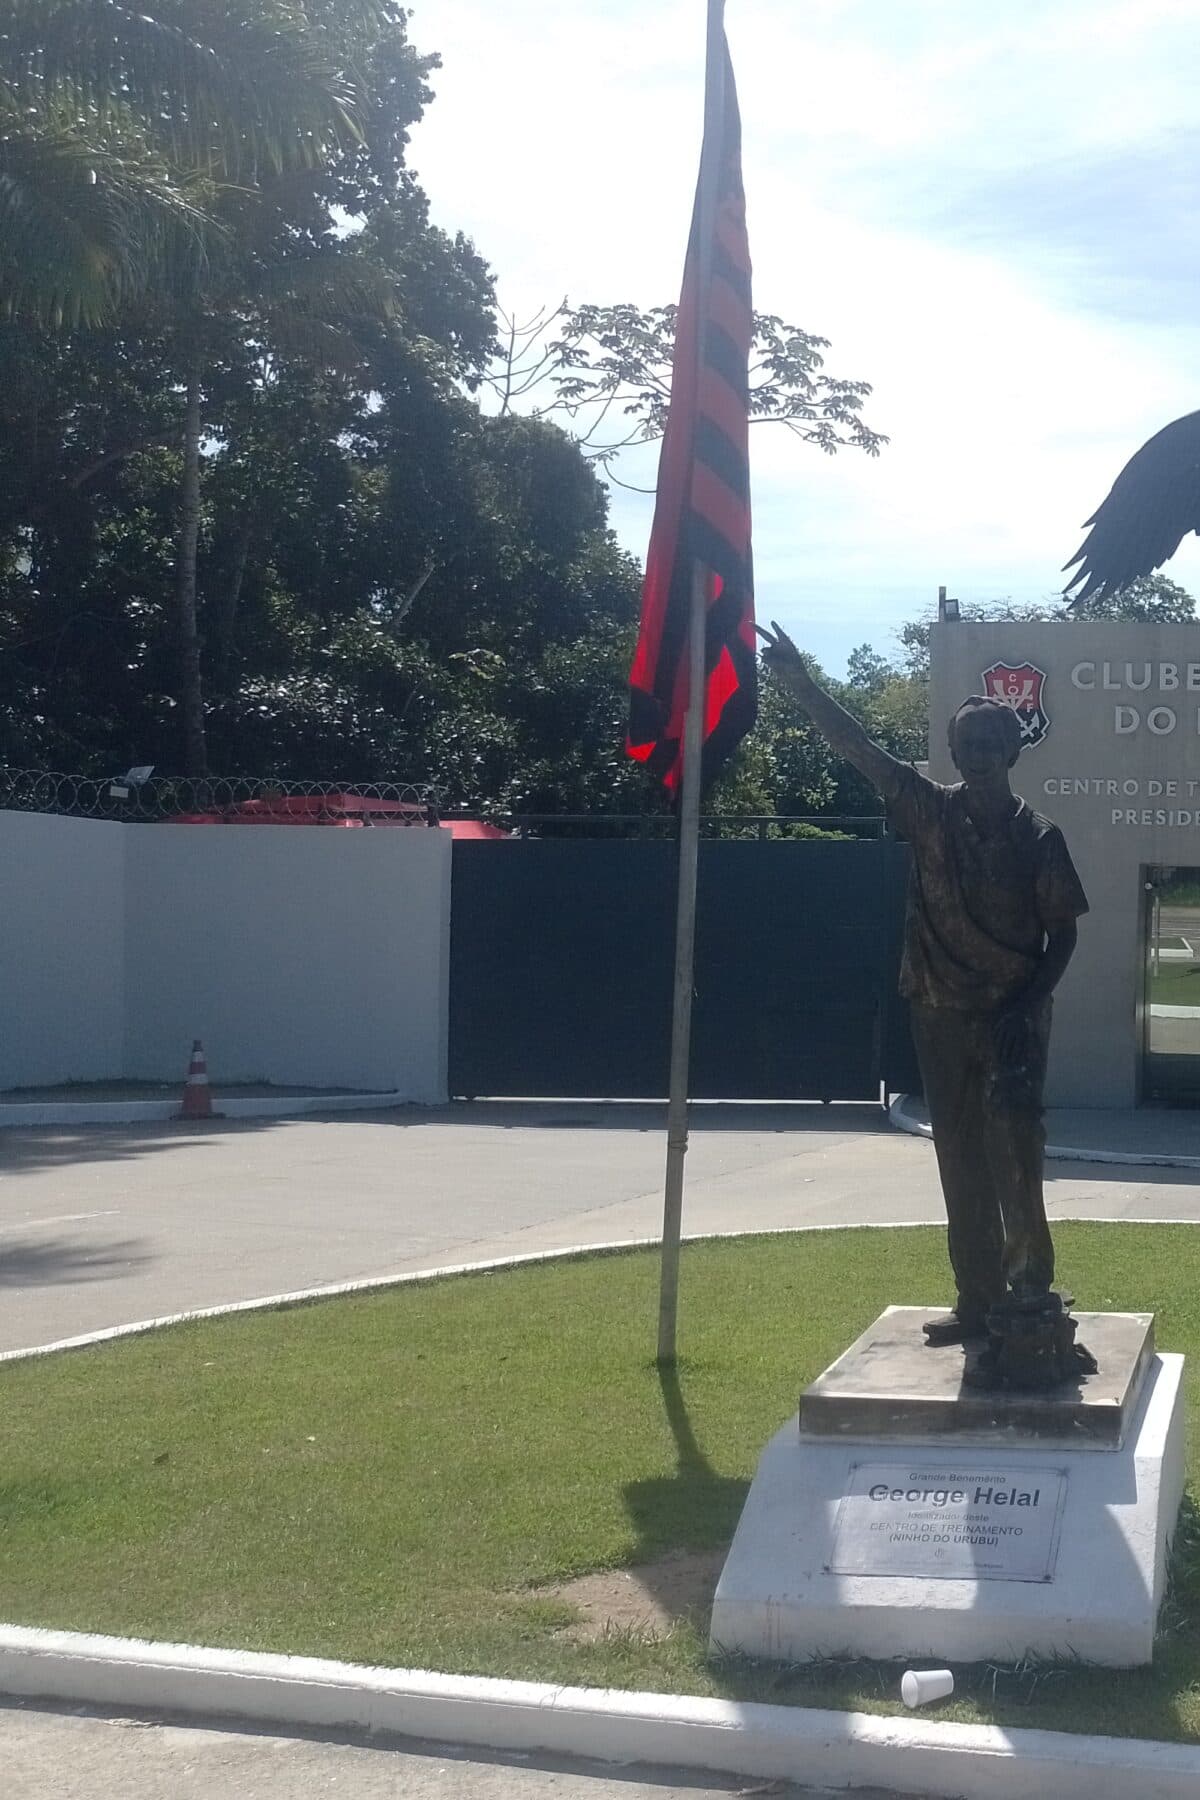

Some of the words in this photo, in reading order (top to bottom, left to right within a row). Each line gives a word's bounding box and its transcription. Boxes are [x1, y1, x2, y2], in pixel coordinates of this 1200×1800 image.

[1114, 706, 1177, 735] DO
[1043, 778, 1140, 796] CENTRO
[1148, 780, 1178, 797] DE
[909, 1472, 946, 1481] Grande
[868, 1484, 965, 1507] George
[973, 1487, 1041, 1507] Helal
[869, 1522, 919, 1532] CENTRO
[921, 1523, 937, 1533] DE
[941, 1524, 1024, 1536] TREINAMENTO
[889, 1534, 930, 1543] (NINHO
[933, 1535, 950, 1543] DO
[954, 1535, 999, 1546] URUBU)
